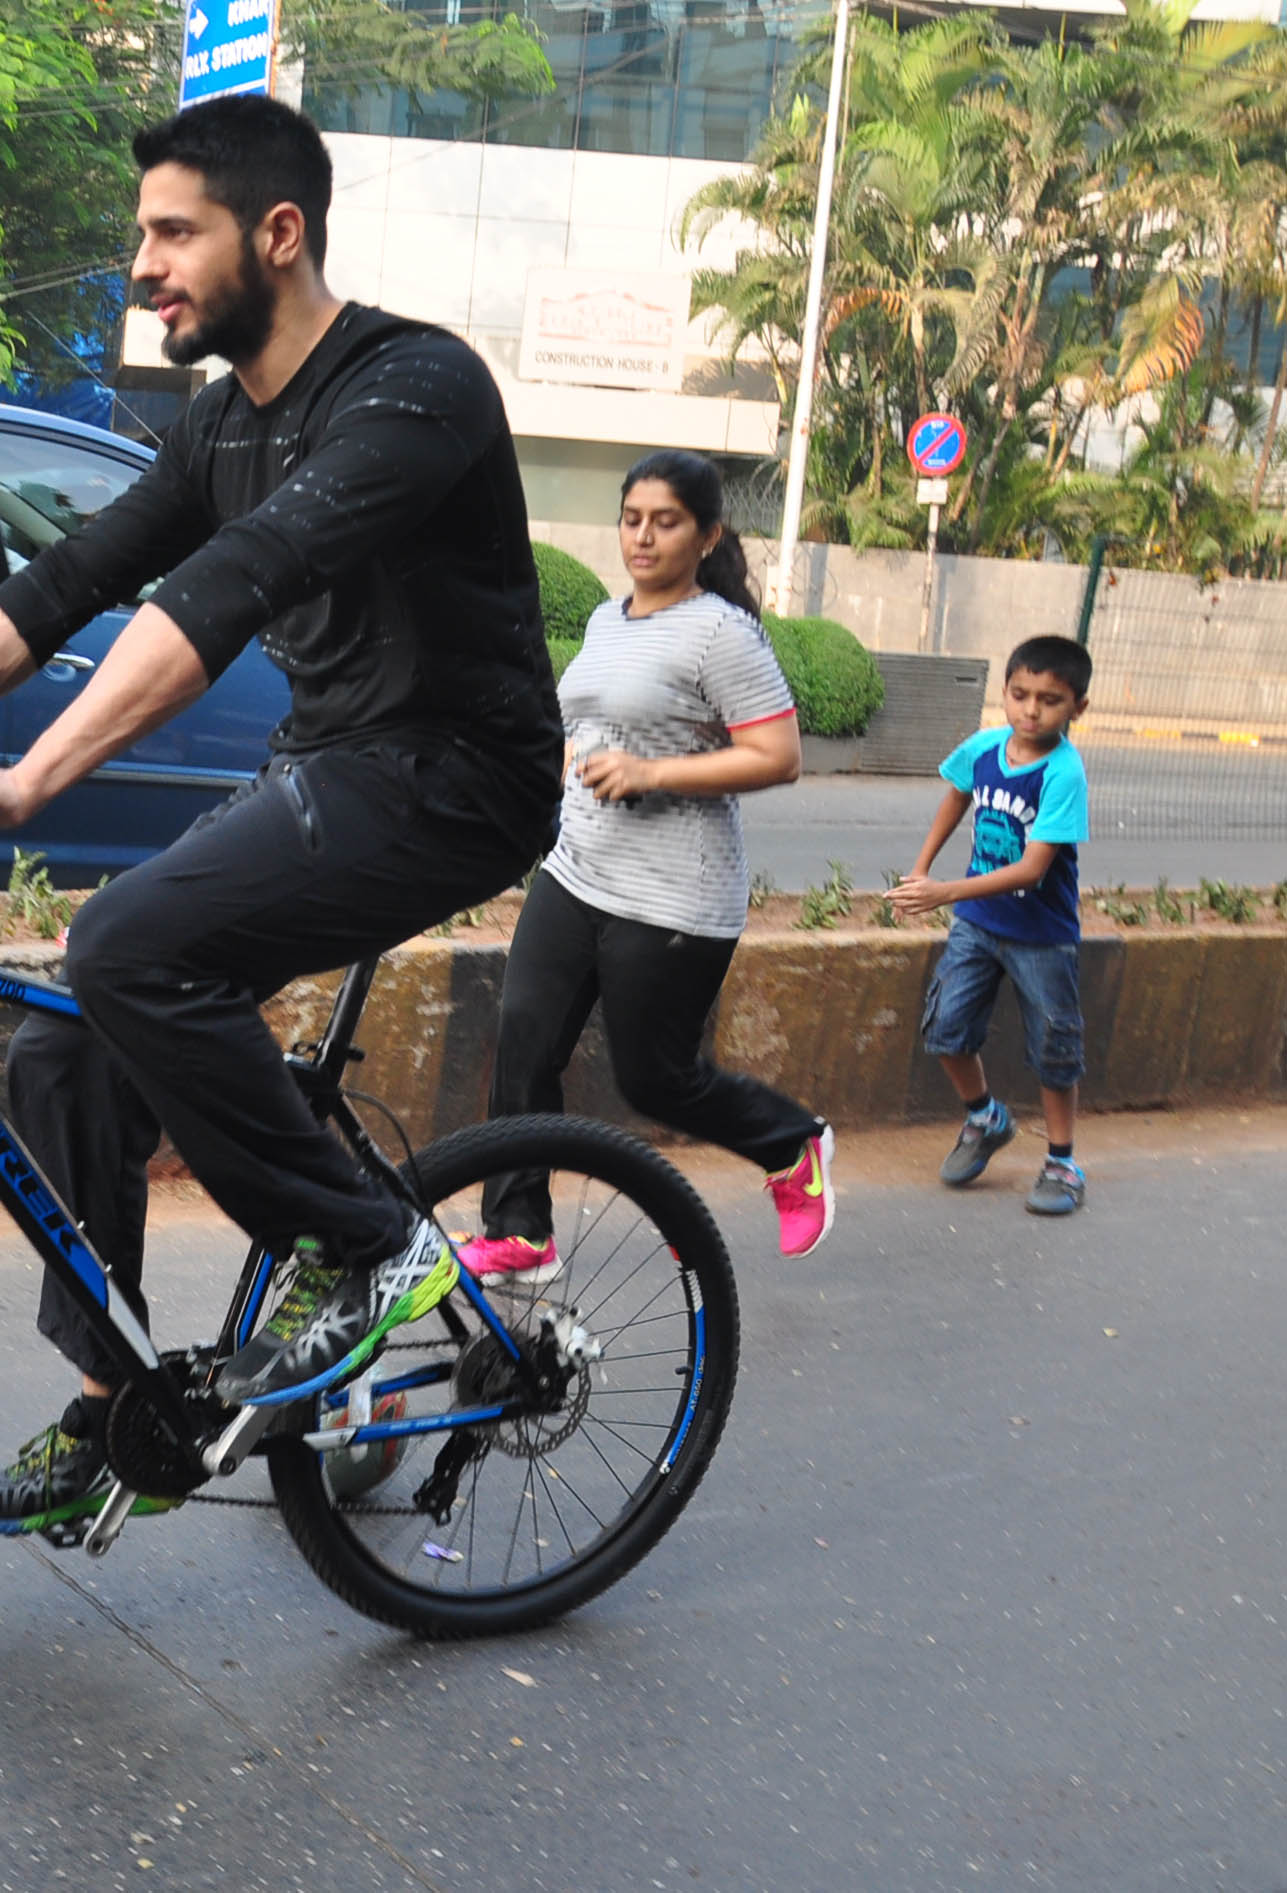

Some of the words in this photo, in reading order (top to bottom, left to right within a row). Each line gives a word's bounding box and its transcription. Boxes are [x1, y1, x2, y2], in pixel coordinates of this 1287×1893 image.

[212, 32, 267, 71] STATION
[535, 351, 614, 370] CONSTRUCTION
[617, 360, 653, 373] HOUSE
